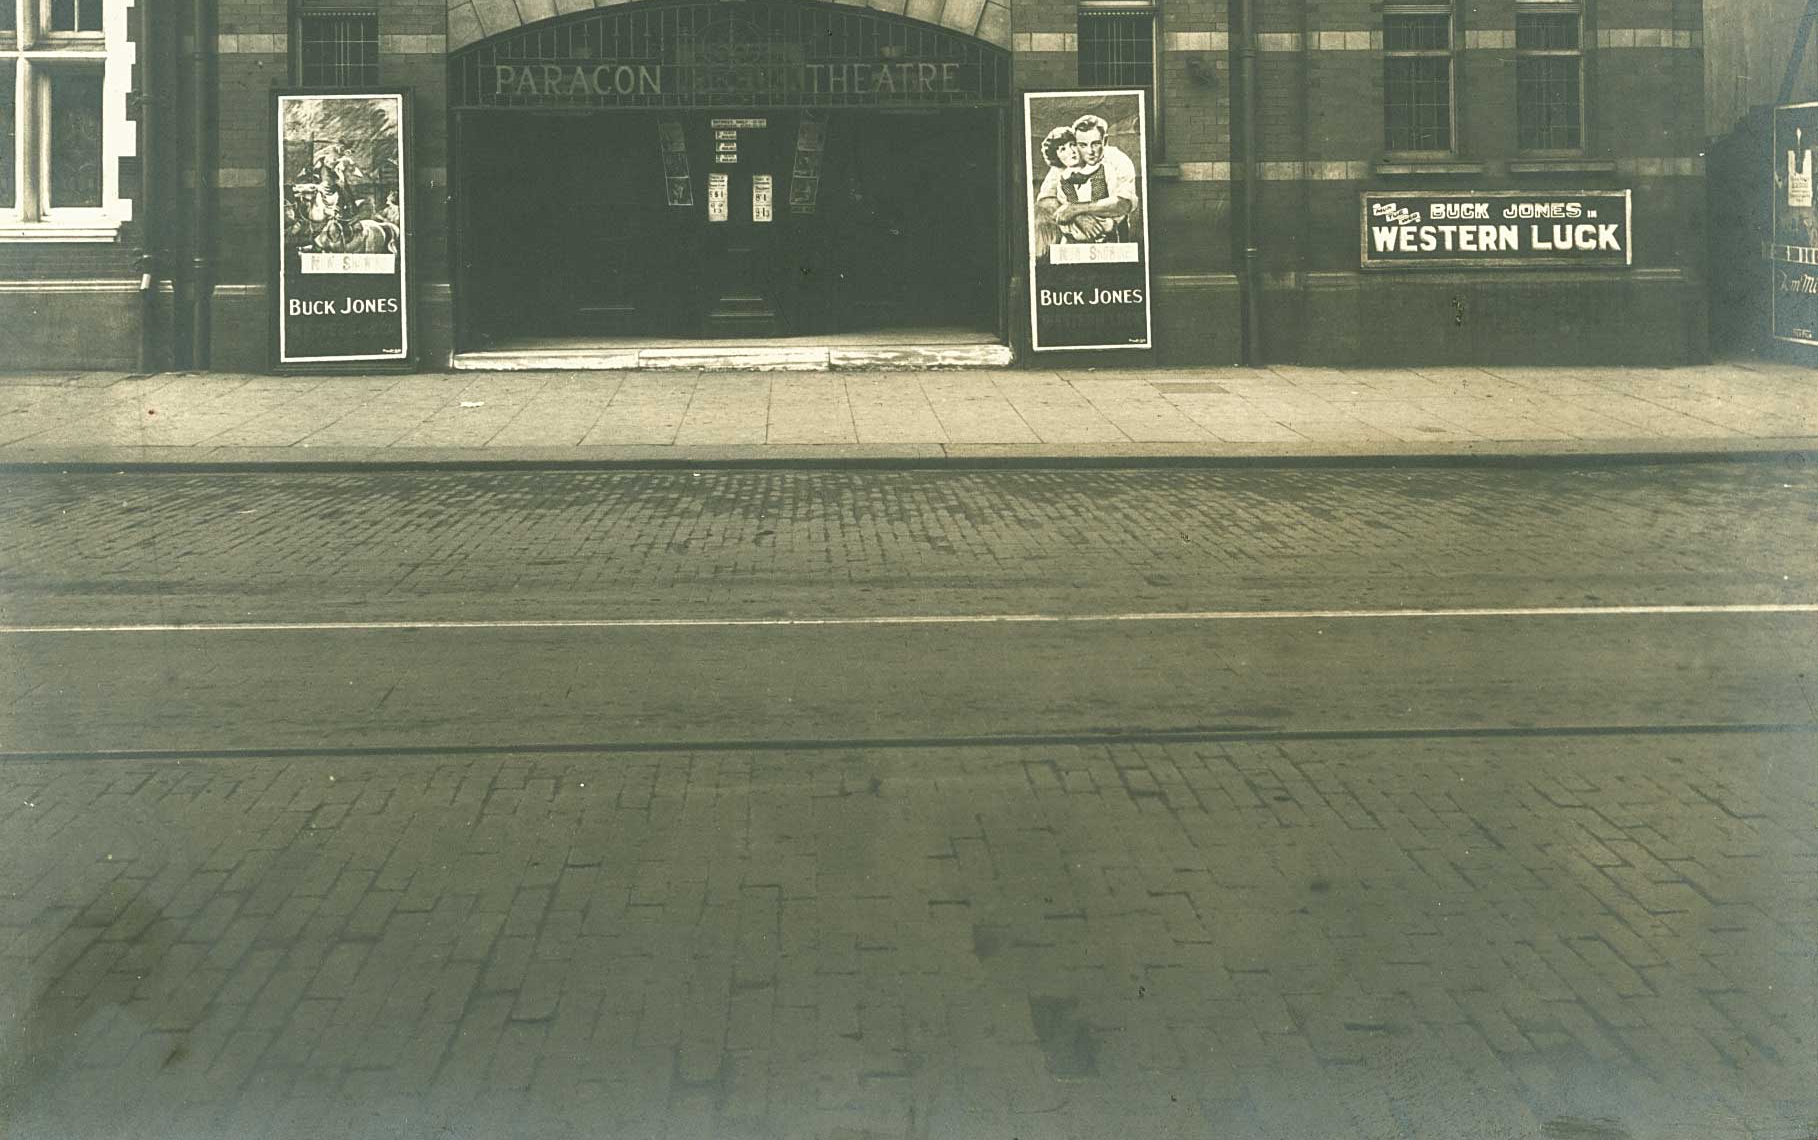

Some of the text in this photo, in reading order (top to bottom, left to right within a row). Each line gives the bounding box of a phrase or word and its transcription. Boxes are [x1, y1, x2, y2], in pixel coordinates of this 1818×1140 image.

[806, 63, 960, 95] THEATRE
[1430, 203, 1490, 220] BUCK
[1502, 202, 1582, 218] JONES
[1372, 224, 1622, 252] WESTERN LUCK
